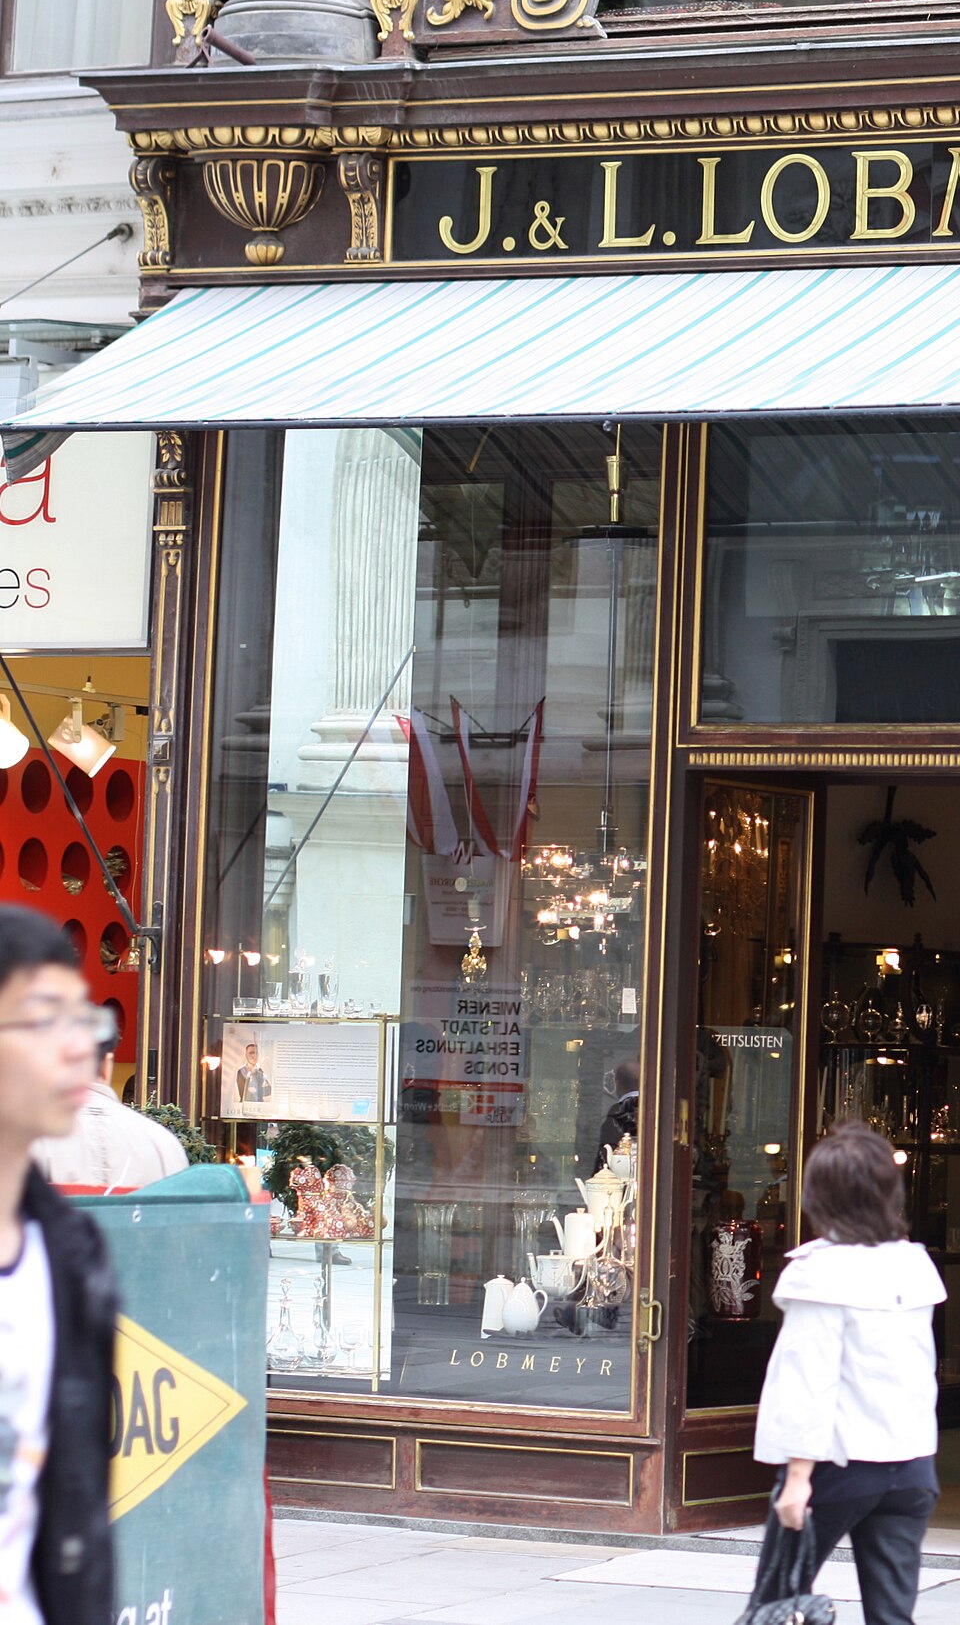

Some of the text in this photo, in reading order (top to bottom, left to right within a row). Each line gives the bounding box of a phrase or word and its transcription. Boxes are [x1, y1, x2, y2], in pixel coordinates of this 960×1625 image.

[438, 166, 516, 253] J.
[528, 200, 569, 251] &
[450, 1349, 612, 1376] LOBMEYR
